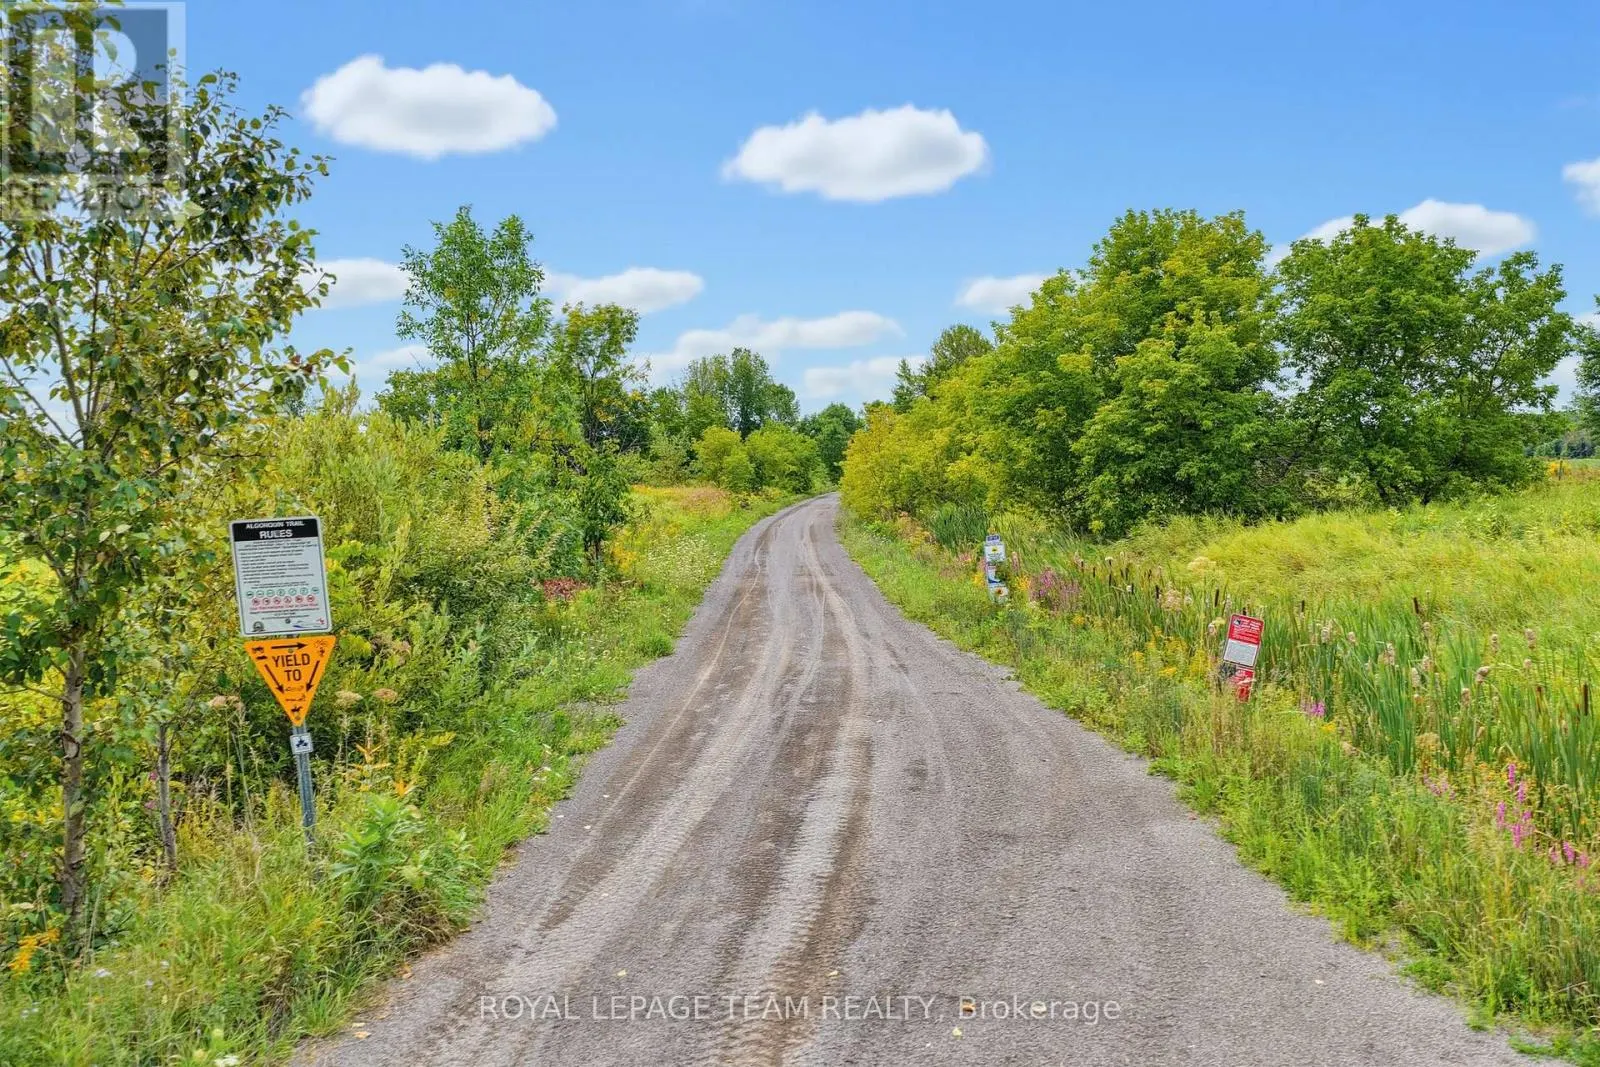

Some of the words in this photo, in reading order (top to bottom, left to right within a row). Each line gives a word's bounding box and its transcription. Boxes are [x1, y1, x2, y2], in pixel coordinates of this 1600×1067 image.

[259, 529, 293, 539] RULES
[272, 654, 310, 667] YIELD
[284, 669, 302, 681] TO
